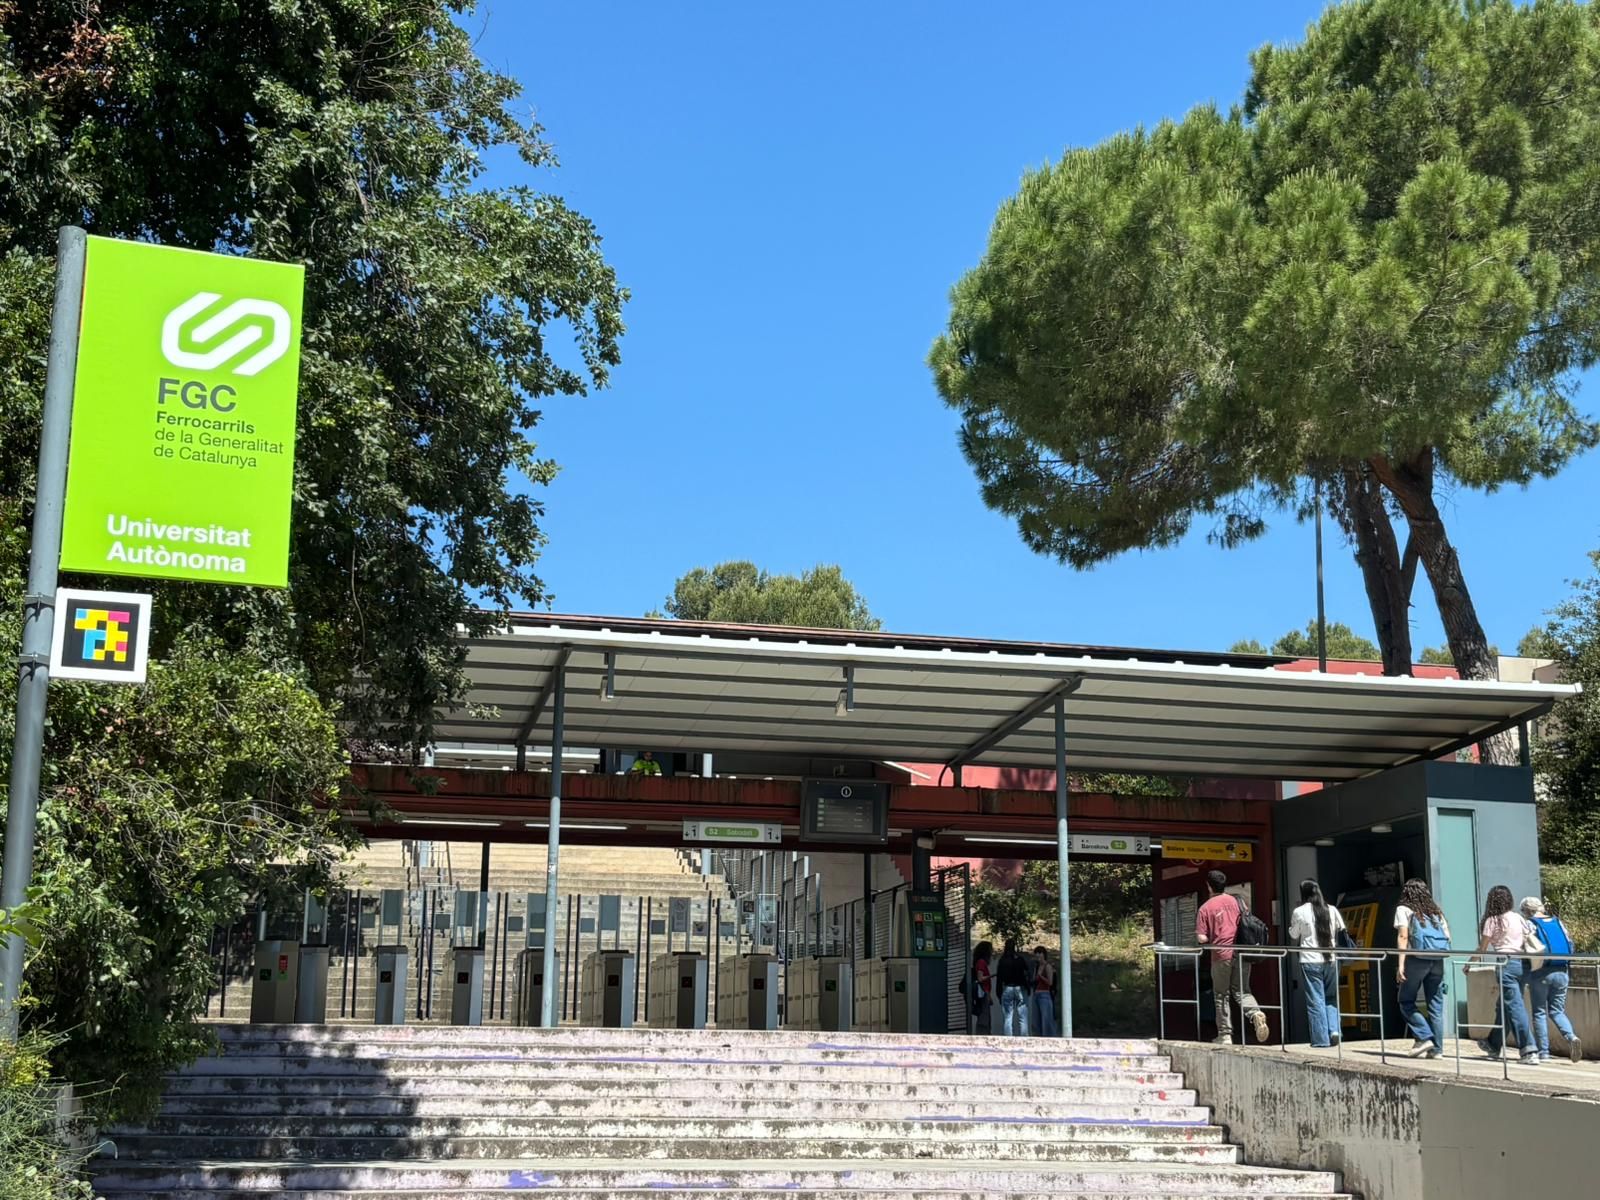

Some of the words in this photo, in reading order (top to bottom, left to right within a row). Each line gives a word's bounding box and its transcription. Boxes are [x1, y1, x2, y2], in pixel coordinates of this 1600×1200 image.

[157, 377, 238, 412] FGC
[156, 411, 256, 435] Ferrocarrils
[154, 428, 176, 443] de
[180, 429, 194, 445] la
[199, 431, 284, 455] Generalitat
[153, 443, 174, 459] de
[178, 446, 258, 469] Catalunya
[106, 513, 252, 548] Universitat
[106, 540, 247, 573] Autònoma
[692, 828, 697, 837] 1
[767, 831, 773, 840] 1
[1136, 843, 1143, 852] 2
